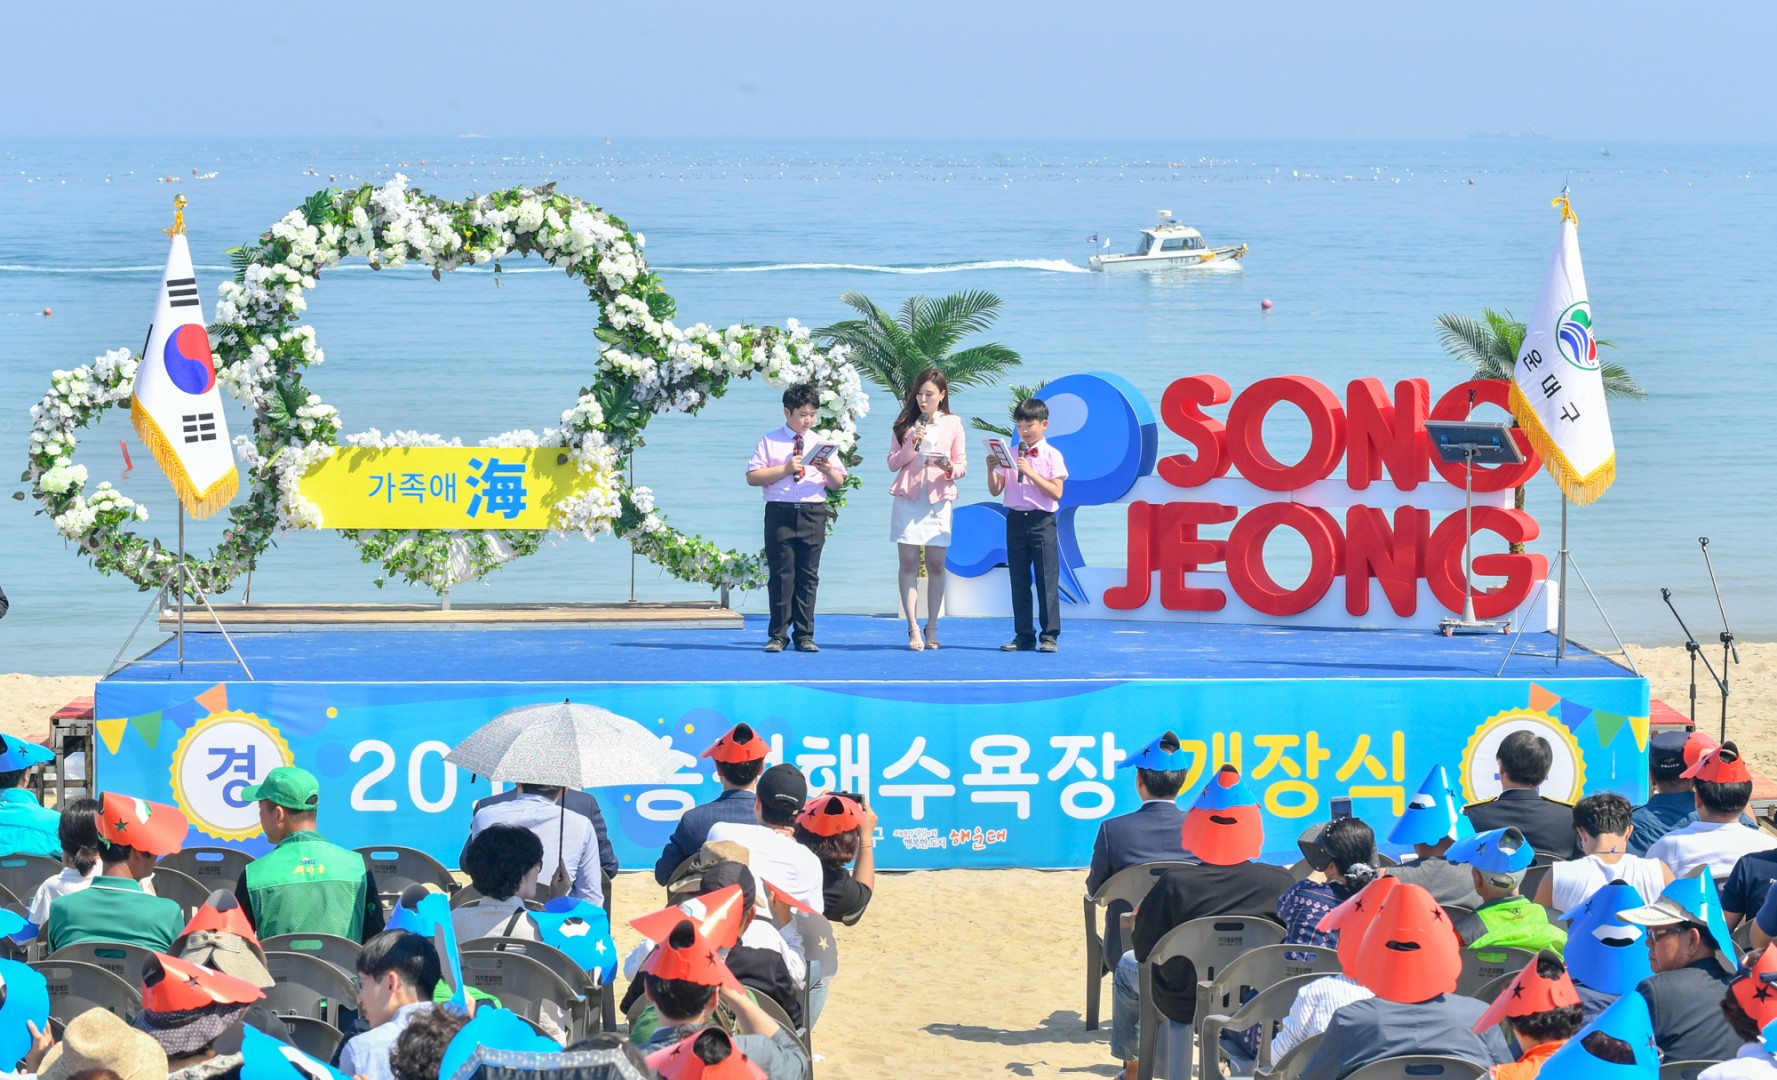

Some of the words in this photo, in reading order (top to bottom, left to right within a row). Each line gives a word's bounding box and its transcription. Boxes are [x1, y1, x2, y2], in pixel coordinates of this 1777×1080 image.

[368, 471, 457, 503] 가족애
[464, 457, 527, 519] 海
[1103, 500, 1547, 619] JEONG
[206, 744, 256, 809] 경
[348, 739, 504, 814] 20
[634, 731, 1127, 821] 송해수욕장
[1176, 730, 1405, 819] 개장식
[903, 837, 929, 849] 행복한
[929, 837, 947, 849] 도시
[949, 826, 1008, 851] 해운대
